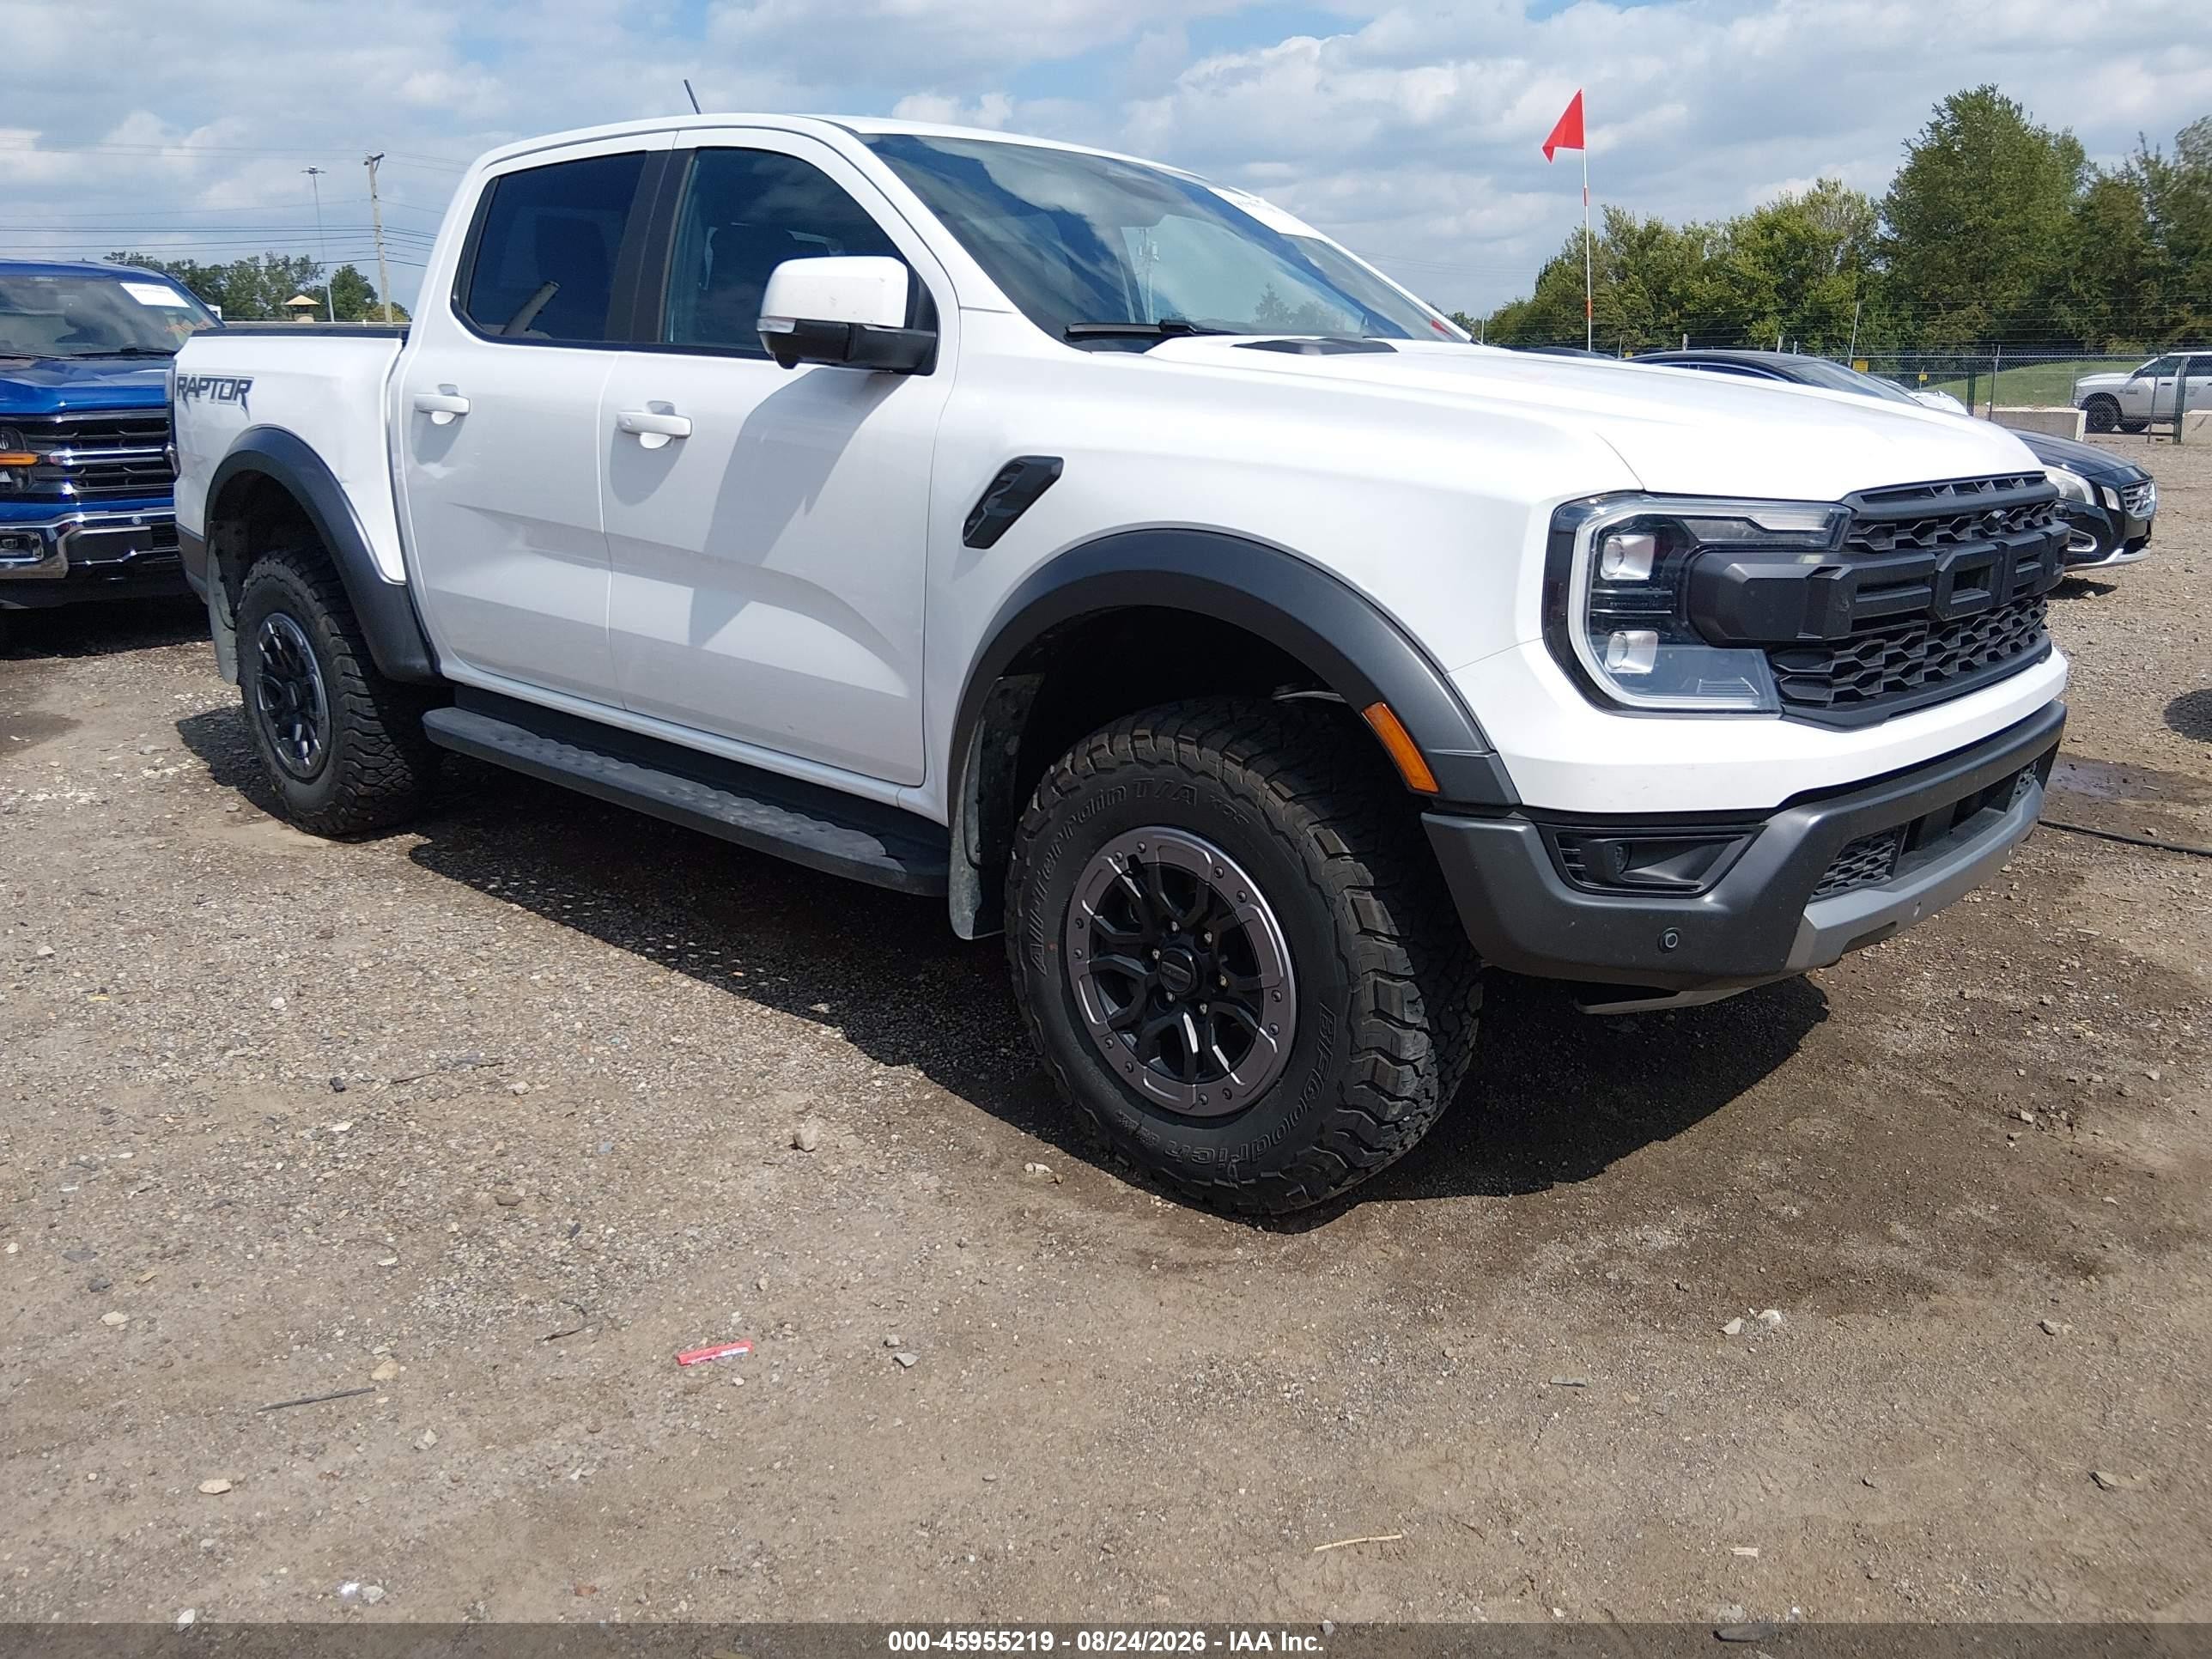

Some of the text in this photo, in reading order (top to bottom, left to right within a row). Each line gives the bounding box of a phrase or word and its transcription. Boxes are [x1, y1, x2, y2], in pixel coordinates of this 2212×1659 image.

[177, 374, 254, 421] RAPTOR
[1133, 777, 1199, 805] T/A
[1163, 1003, 1336, 1164] BFGoodrich
